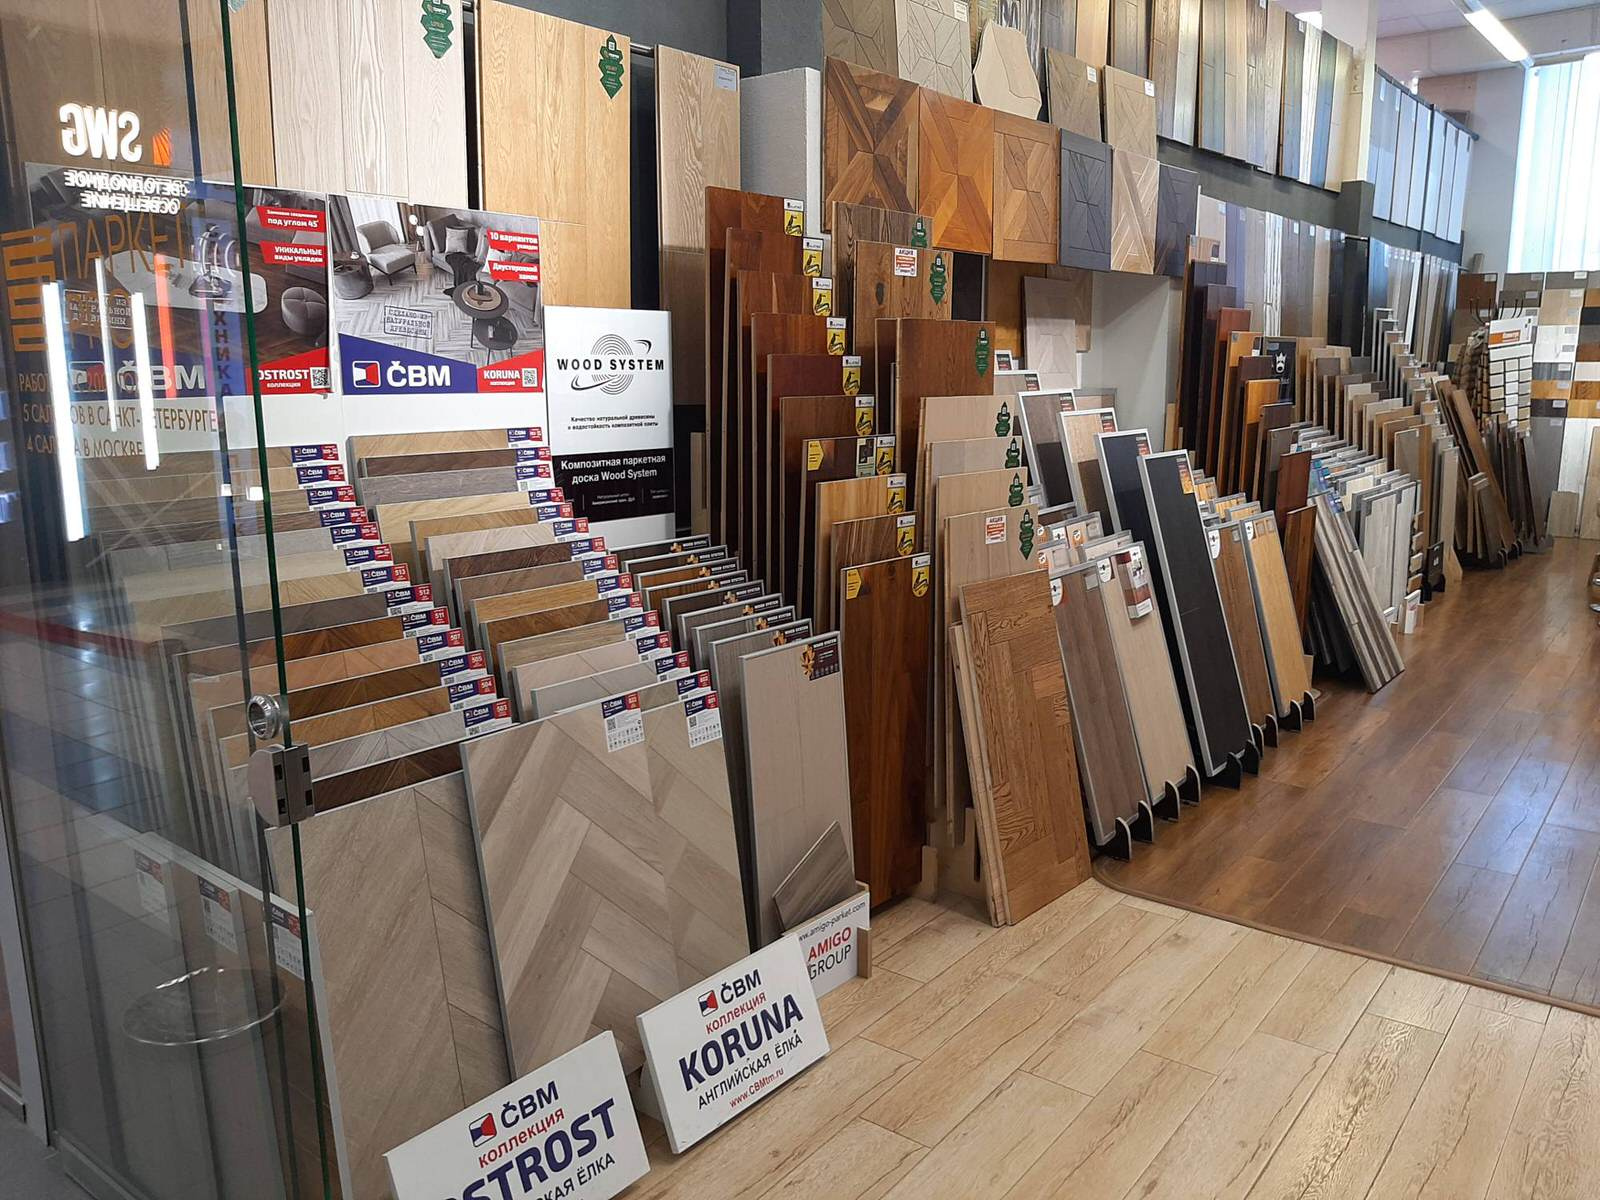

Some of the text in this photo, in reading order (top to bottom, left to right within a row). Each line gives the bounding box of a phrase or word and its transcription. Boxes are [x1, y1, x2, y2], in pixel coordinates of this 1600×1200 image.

[268, 218, 284, 226] под
[490, 232, 499, 240] 10
[274, 255, 294, 263] виды
[275, 246, 323, 256] УНИКАЛЬНЫЕ
[386, 360, 451, 387] ČBM
[483, 369, 521, 380] KORUNA
[557, 359, 664, 370] WOOD SYSTEM
[561, 455, 666, 470] Композитная паркетная
[572, 468, 657, 485] доска Wood System
[808, 927, 851, 962] AMIGO
[808, 944, 851, 980] GROUP
[720, 968, 762, 1004] ČBM
[706, 992, 767, 1035] коллекция
[679, 993, 804, 1092] KORUNA
[698, 1033, 803, 1110] АНГЛИЙСКАЯ ЁЛКА
[729, 1067, 785, 1109] www.CBMtm.ru
[500, 1080, 559, 1129] ČBM
[443, 1098, 615, 1200] STROST
[479, 1108, 565, 1169] коллекция
[577, 1153, 616, 1186] ЁЛКА
